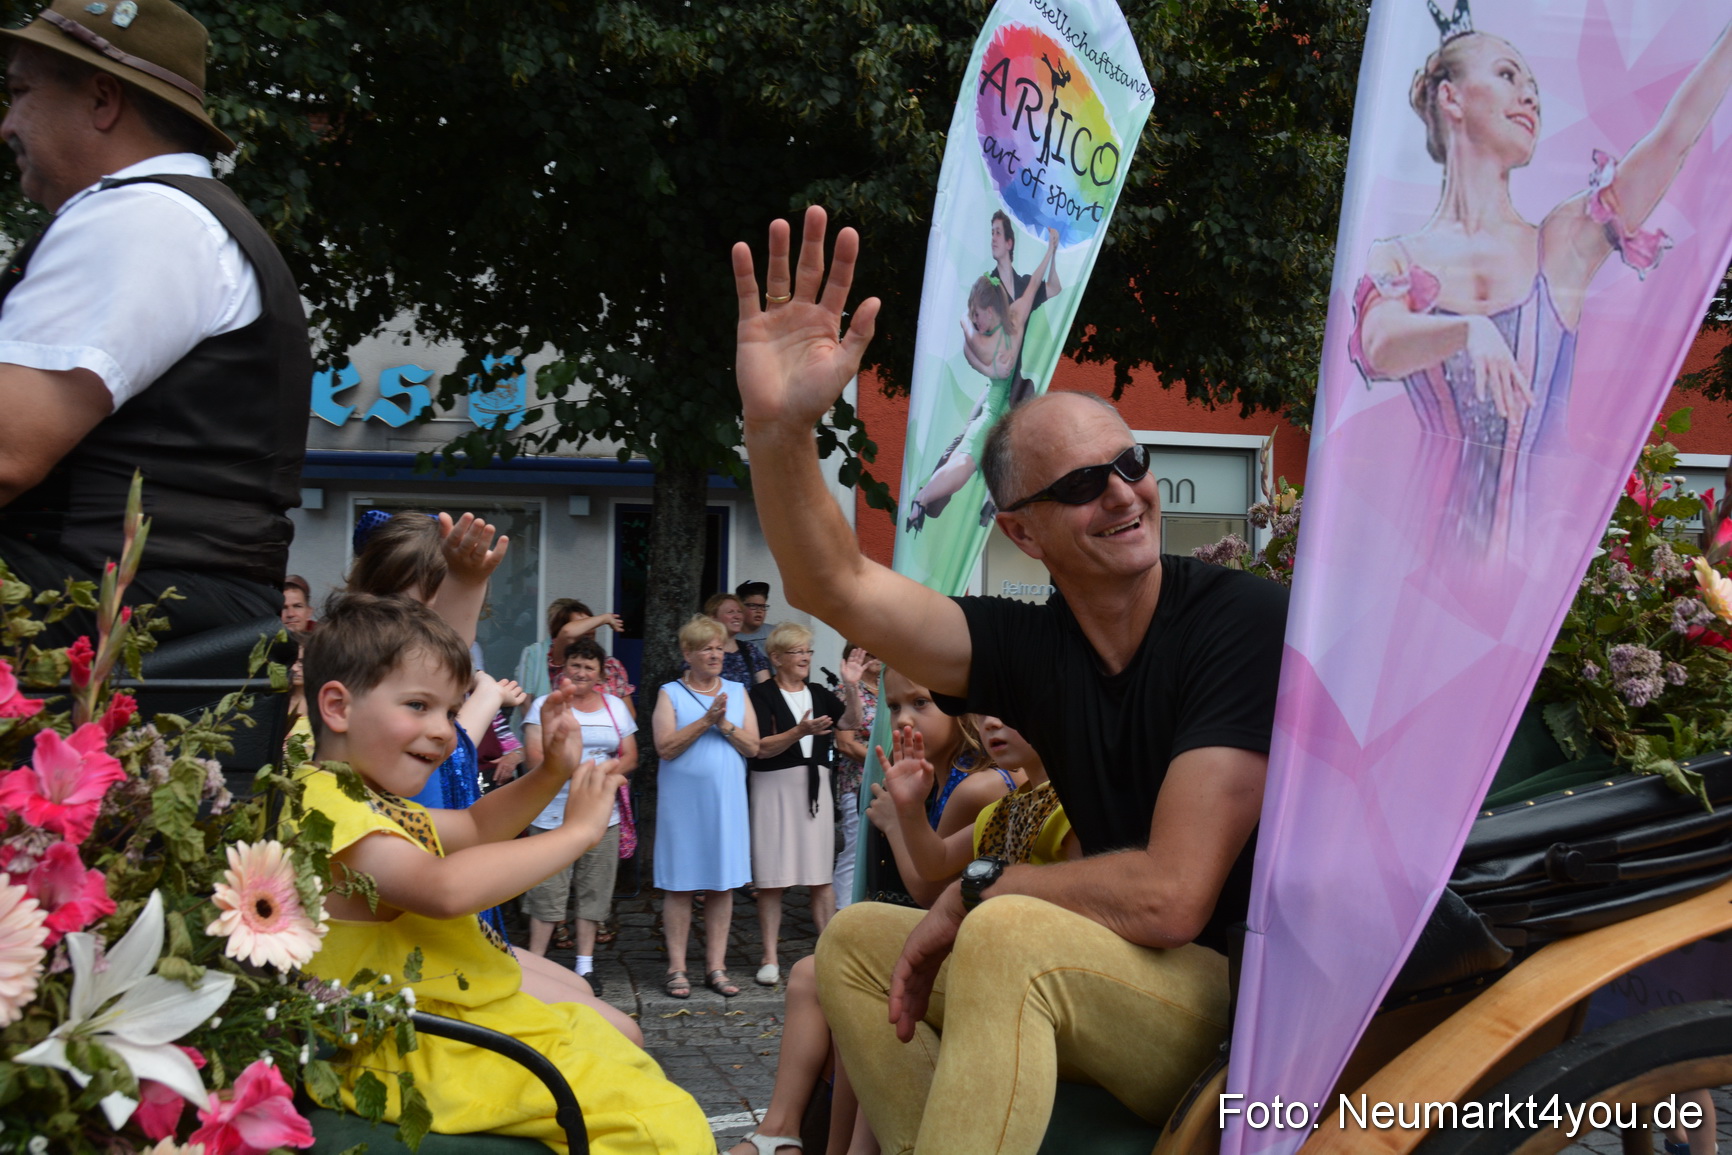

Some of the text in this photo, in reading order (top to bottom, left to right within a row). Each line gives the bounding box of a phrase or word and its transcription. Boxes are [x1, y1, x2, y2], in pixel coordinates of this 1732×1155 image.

[1029, 0, 1150, 101] esellschaftstanz
[983, 136, 1104, 222] art of sport
